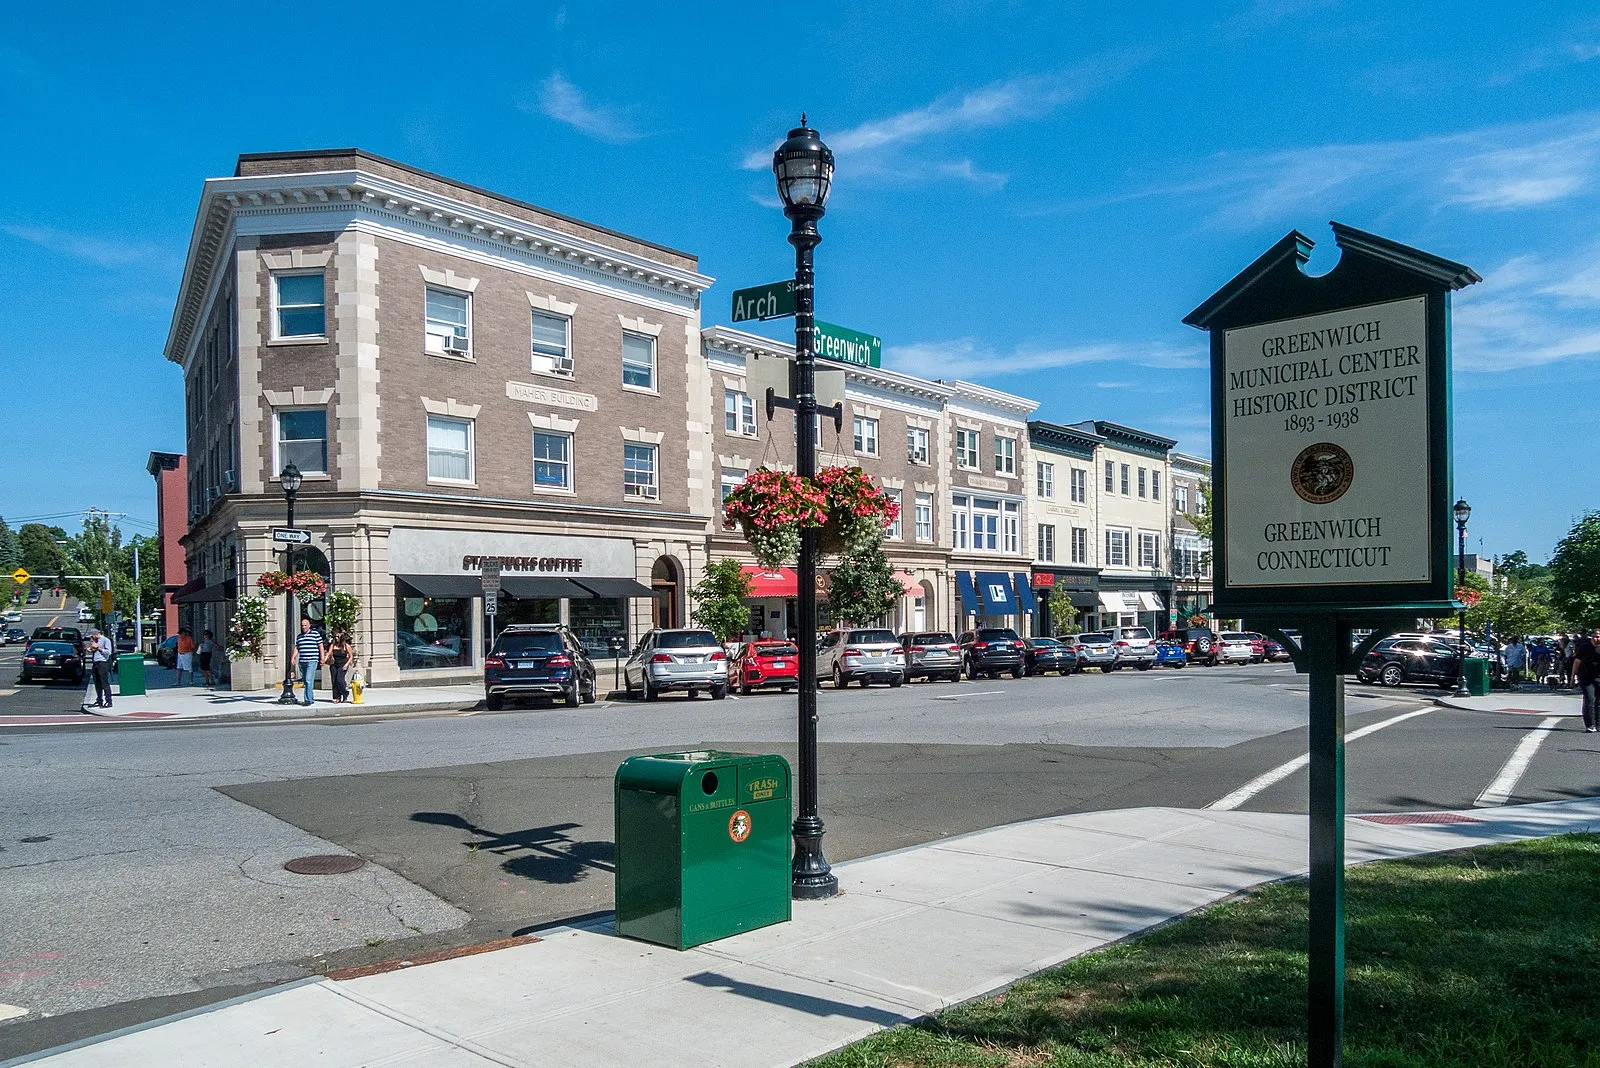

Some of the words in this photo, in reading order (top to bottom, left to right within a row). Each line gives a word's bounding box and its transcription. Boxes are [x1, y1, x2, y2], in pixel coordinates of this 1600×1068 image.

[734, 290, 777, 321] Arch
[786, 281, 795, 292] St
[813, 327, 871, 365] Greenwich
[1262, 320, 1381, 358] GREENWICH
[1230, 358, 1333, 391] MUNICIPAL
[1338, 345, 1421, 375] CENTER
[514, 386, 546, 401] MAHER
[551, 393, 590, 407] BUILDING
[1233, 388, 1318, 418] HISTORIC
[1325, 375, 1418, 406] DISTRICT
[1284, 414, 1315, 433] 1893
[1327, 406, 1359, 430] 1938
[1264, 517, 1381, 543] GREENWICH
[538, 557, 583, 571] COFFEE
[1257, 546, 1391, 571] CONNECTICUT
[486, 603, 496, 613] 25
[748, 779, 778, 791] TRASH
[689, 803, 705, 812] CANS
[710, 799, 735, 809] BOTTLES
